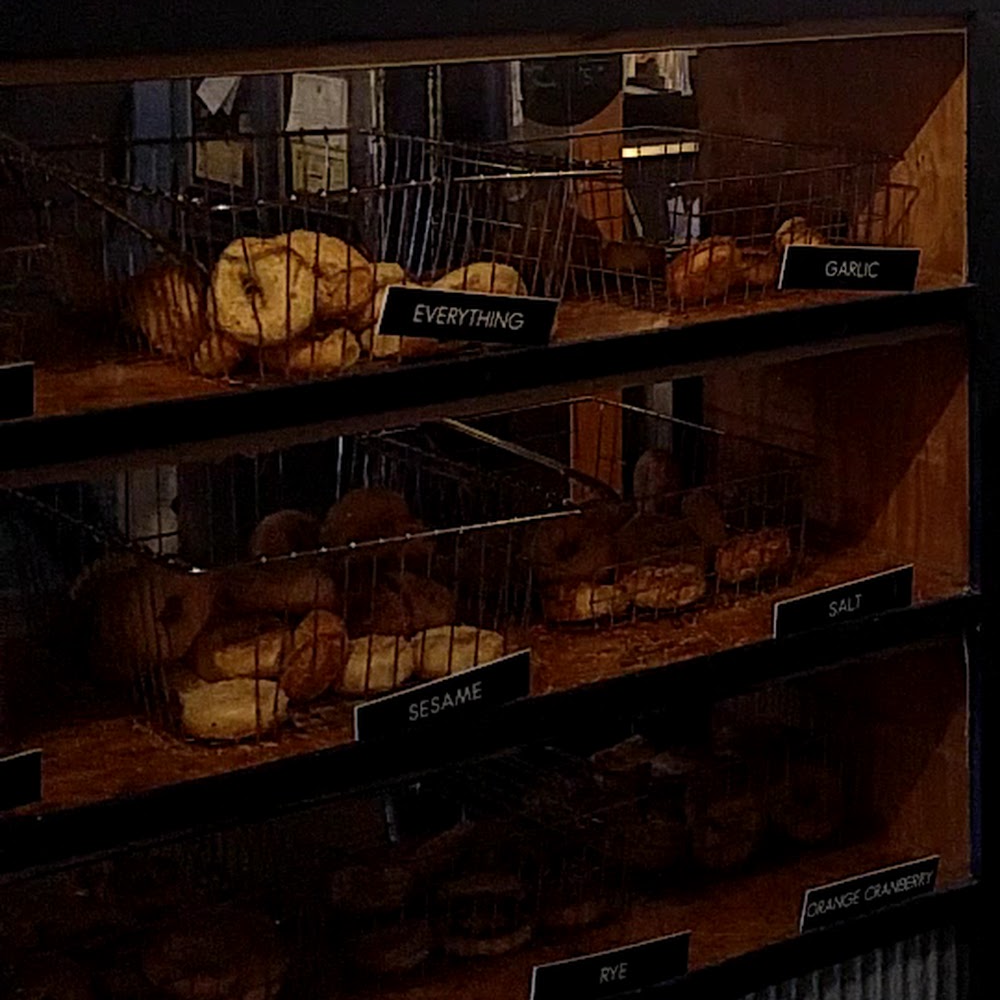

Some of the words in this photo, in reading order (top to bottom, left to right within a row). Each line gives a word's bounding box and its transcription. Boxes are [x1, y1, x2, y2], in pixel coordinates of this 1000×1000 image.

[824, 260, 880, 279] GARLIC
[412, 303, 525, 331] EVERYTHING
[828, 593, 863, 618] SALT
[408, 682, 483, 720] SESAME
[806, 889, 860, 918] ORANGE
[864, 870, 935, 901] CRANBERRY
[599, 962, 628, 984] RYE
